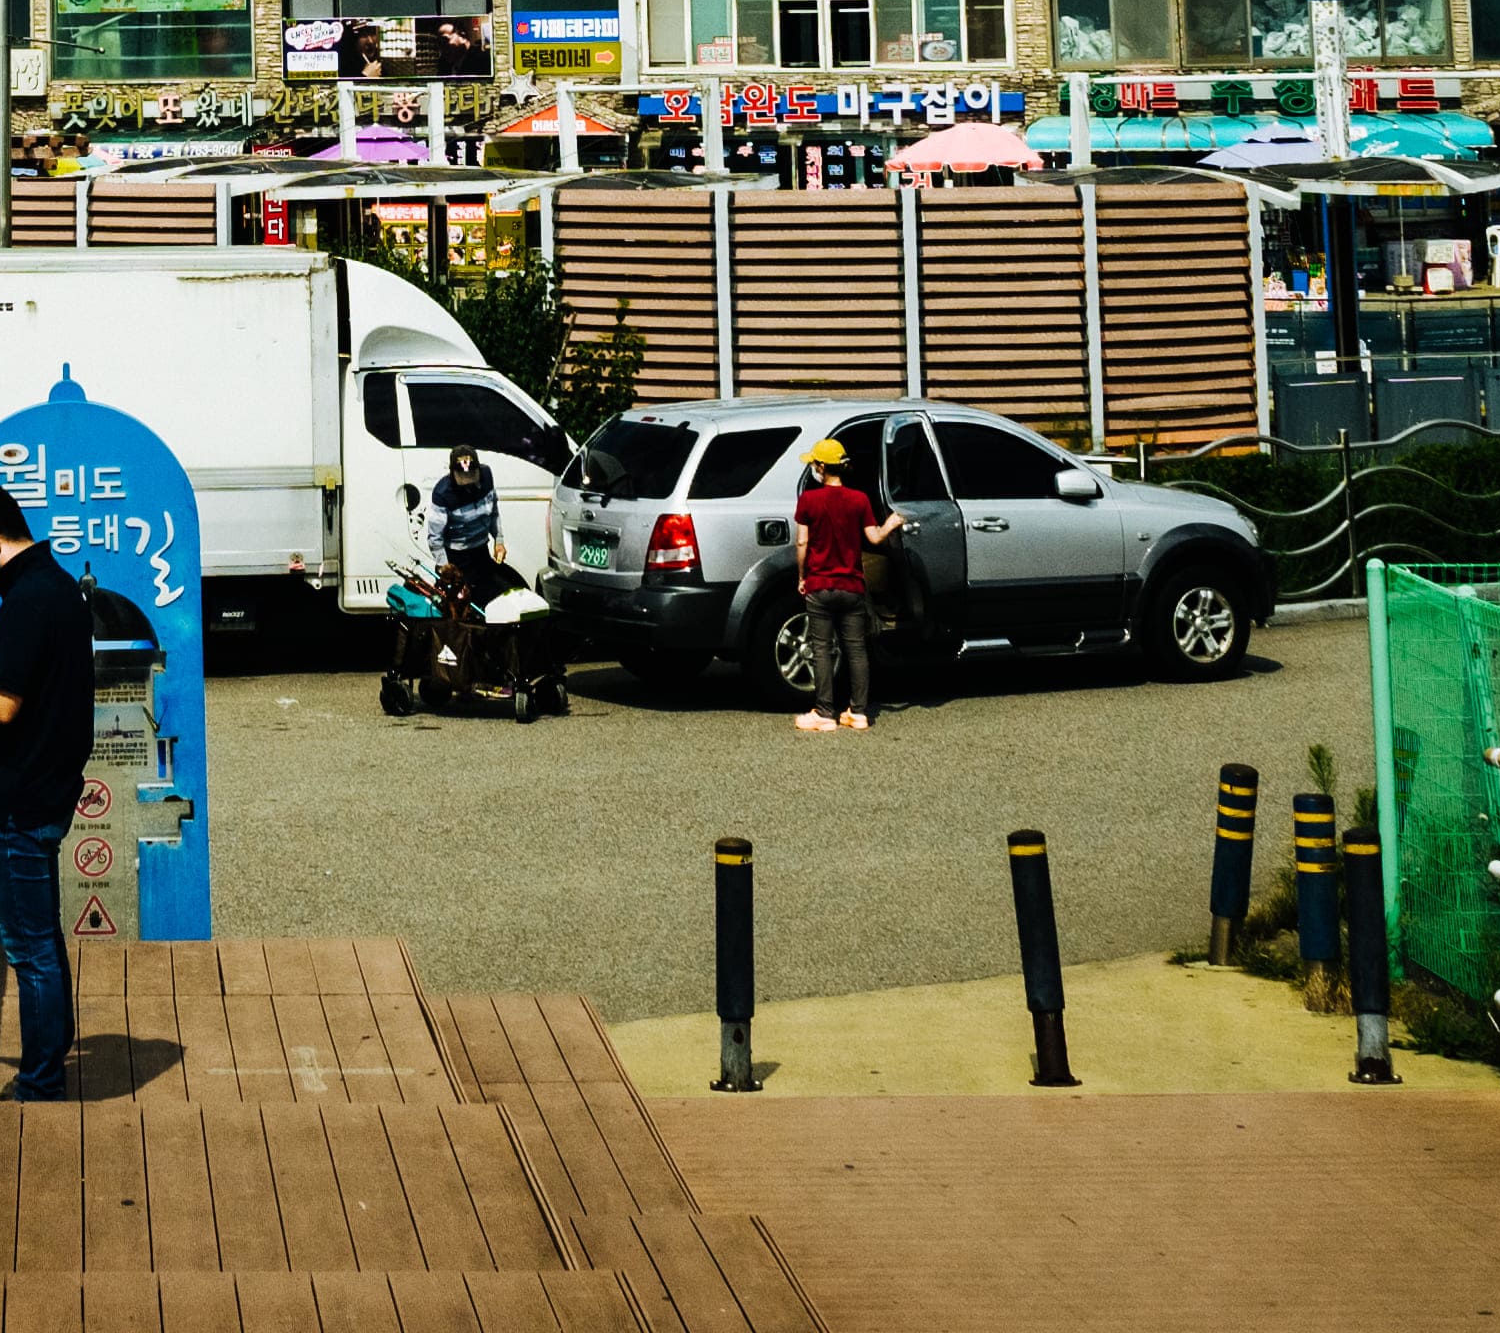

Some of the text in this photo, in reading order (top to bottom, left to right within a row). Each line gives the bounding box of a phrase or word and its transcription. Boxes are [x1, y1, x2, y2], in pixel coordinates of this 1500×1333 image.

[61, 88, 253, 130] 못잊어 또 왔네
[837, 82, 1001, 126] 마구잡이
[189, 144, 238, 157] 763-9040
[579, 544, 608, 566] 2989
